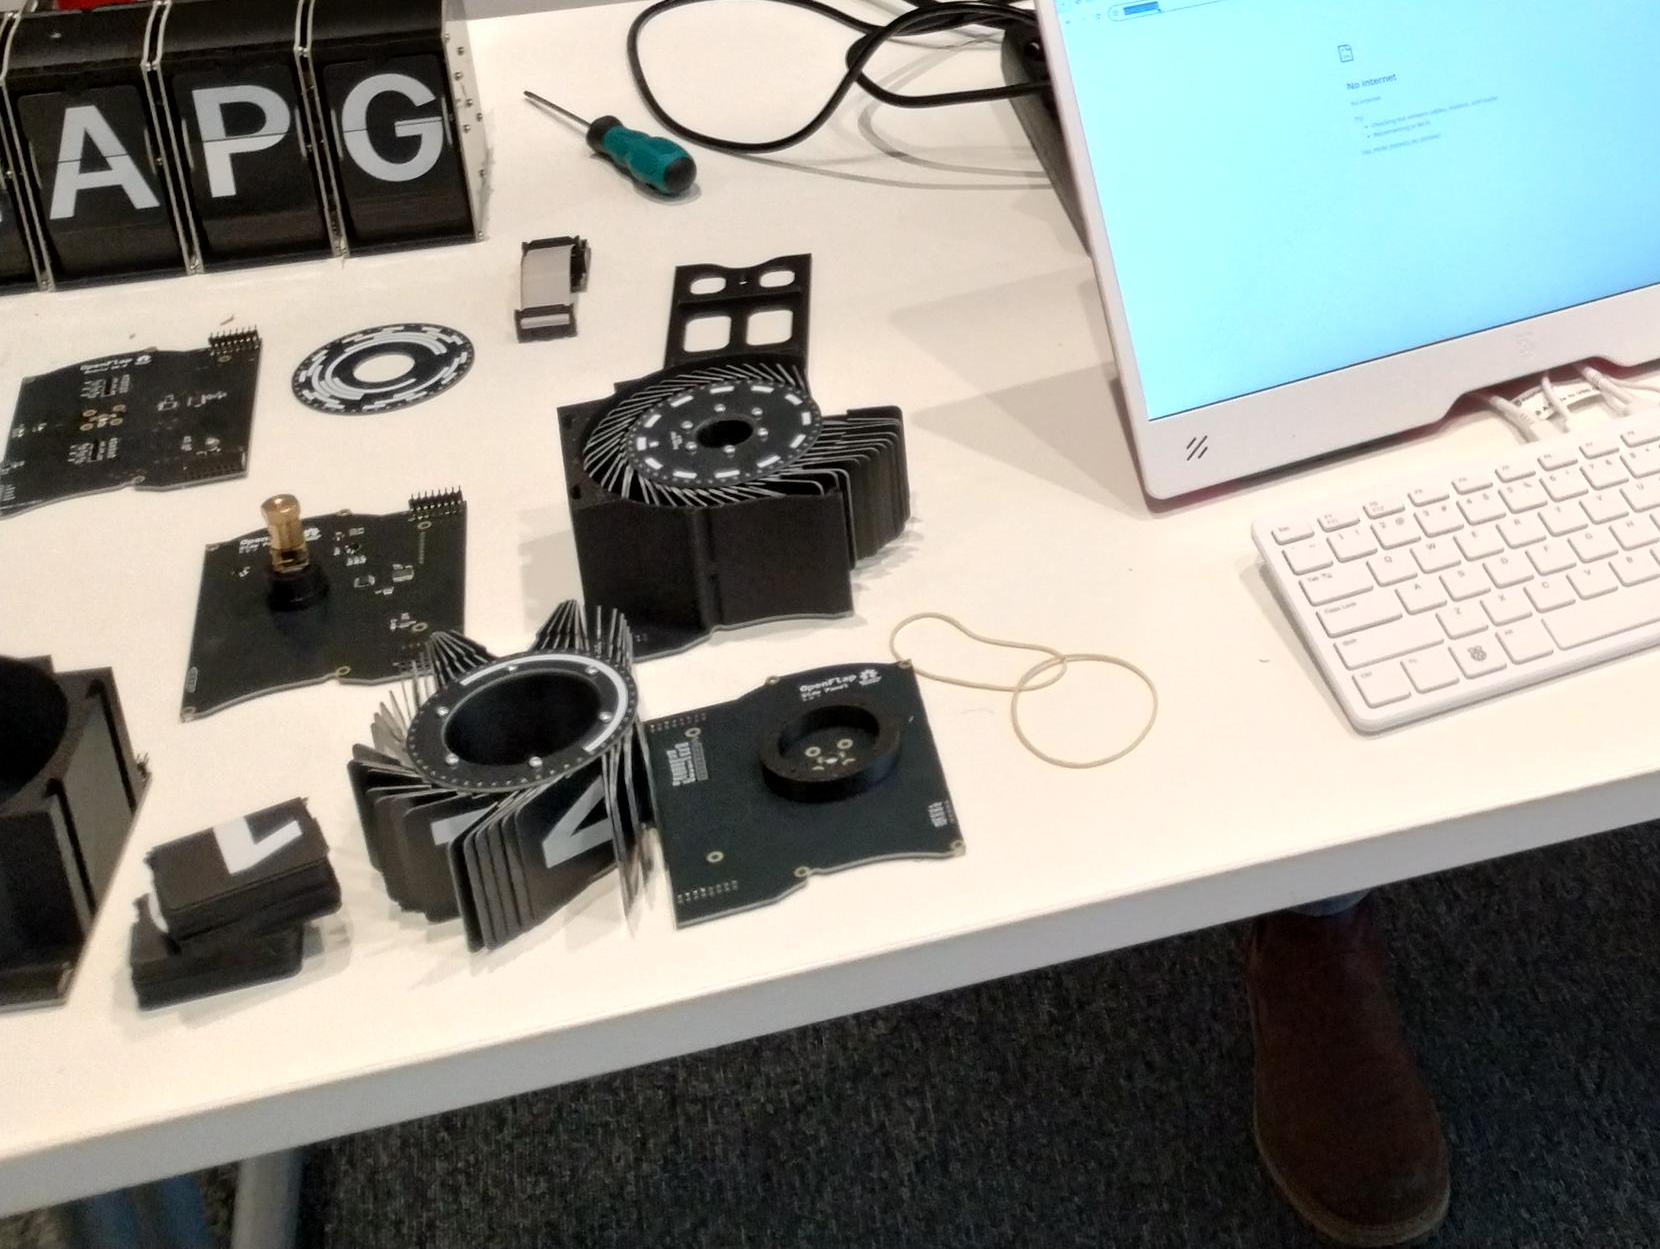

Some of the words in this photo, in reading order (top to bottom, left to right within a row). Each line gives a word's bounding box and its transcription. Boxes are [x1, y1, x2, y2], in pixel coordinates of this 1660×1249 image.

[1347, 82, 1360, 91] No
[1361, 73, 1397, 87] internet
[0, 73, 443, 220] APG
[800, 674, 857, 692] OpenFlap
